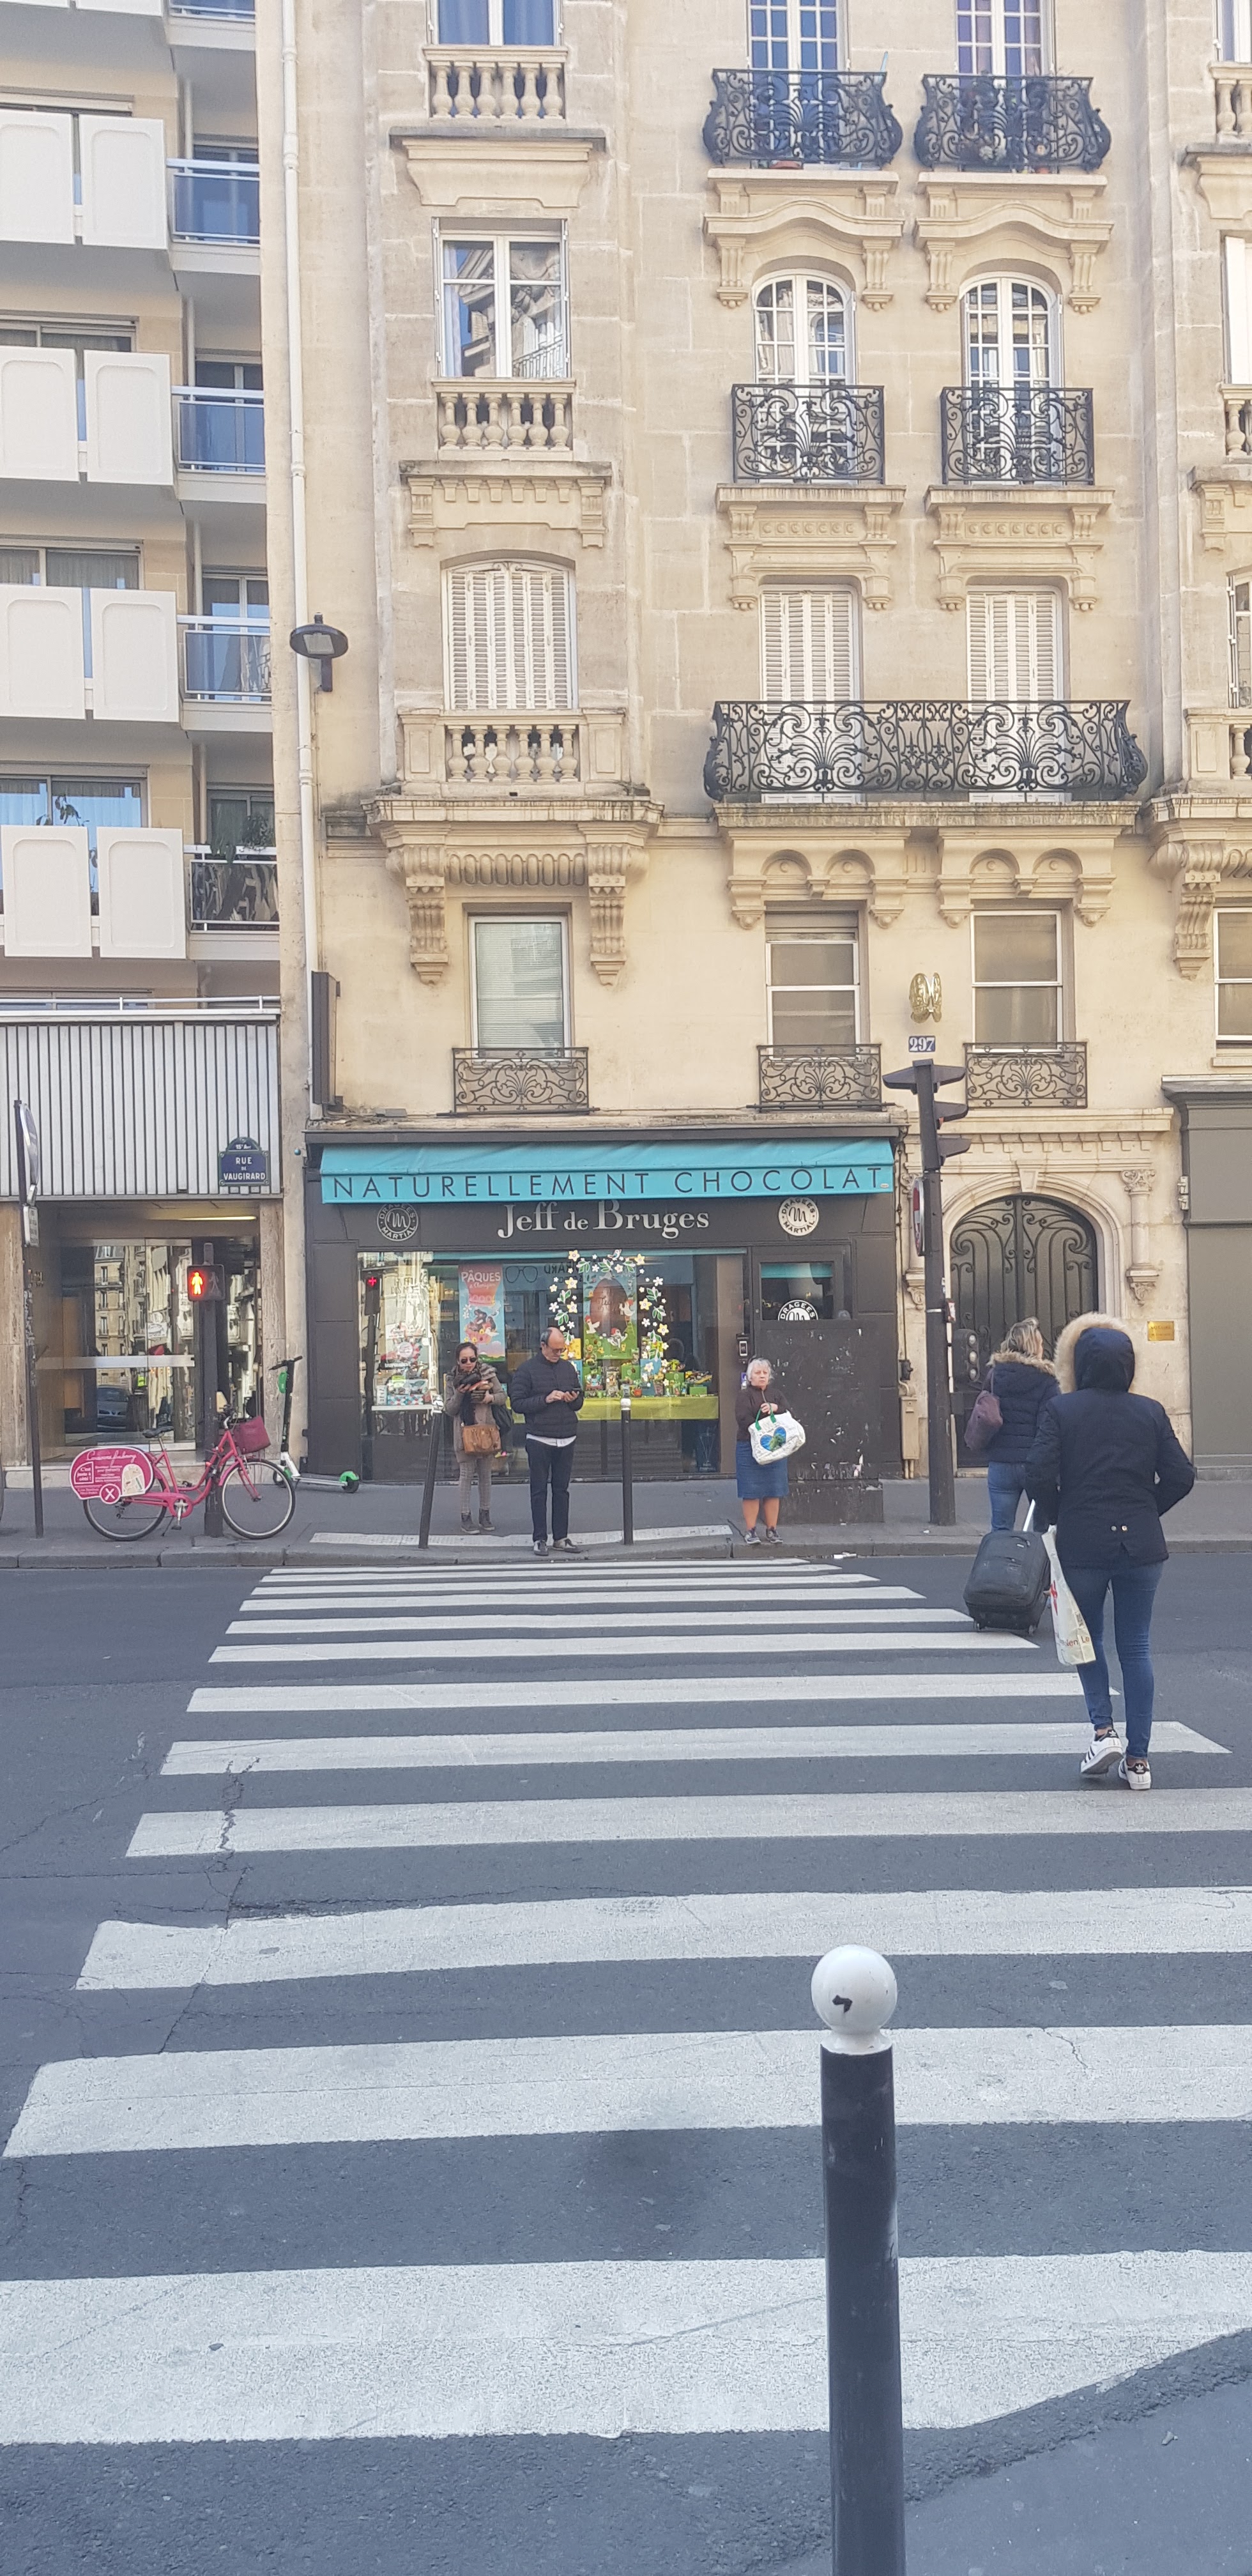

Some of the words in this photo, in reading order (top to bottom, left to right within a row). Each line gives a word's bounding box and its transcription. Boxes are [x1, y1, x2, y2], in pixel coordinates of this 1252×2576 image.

[909, 1037, 935, 1051] 297
[224, 1172, 265, 1181] VAUGIRARD
[333, 1173, 649, 1198] NATURELLEMENT
[675, 1167, 882, 1193] CHOCOLAT
[497, 1201, 559, 1238] Jeff
[563, 1211, 589, 1230] de
[593, 1199, 710, 1239] Bruges
[381, 1225, 416, 1239] MARTIAL
[783, 1220, 815, 1234] MARTIAL
[461, 1269, 501, 1283] PÂQUES
[780, 1301, 816, 1320] DRAGEES
